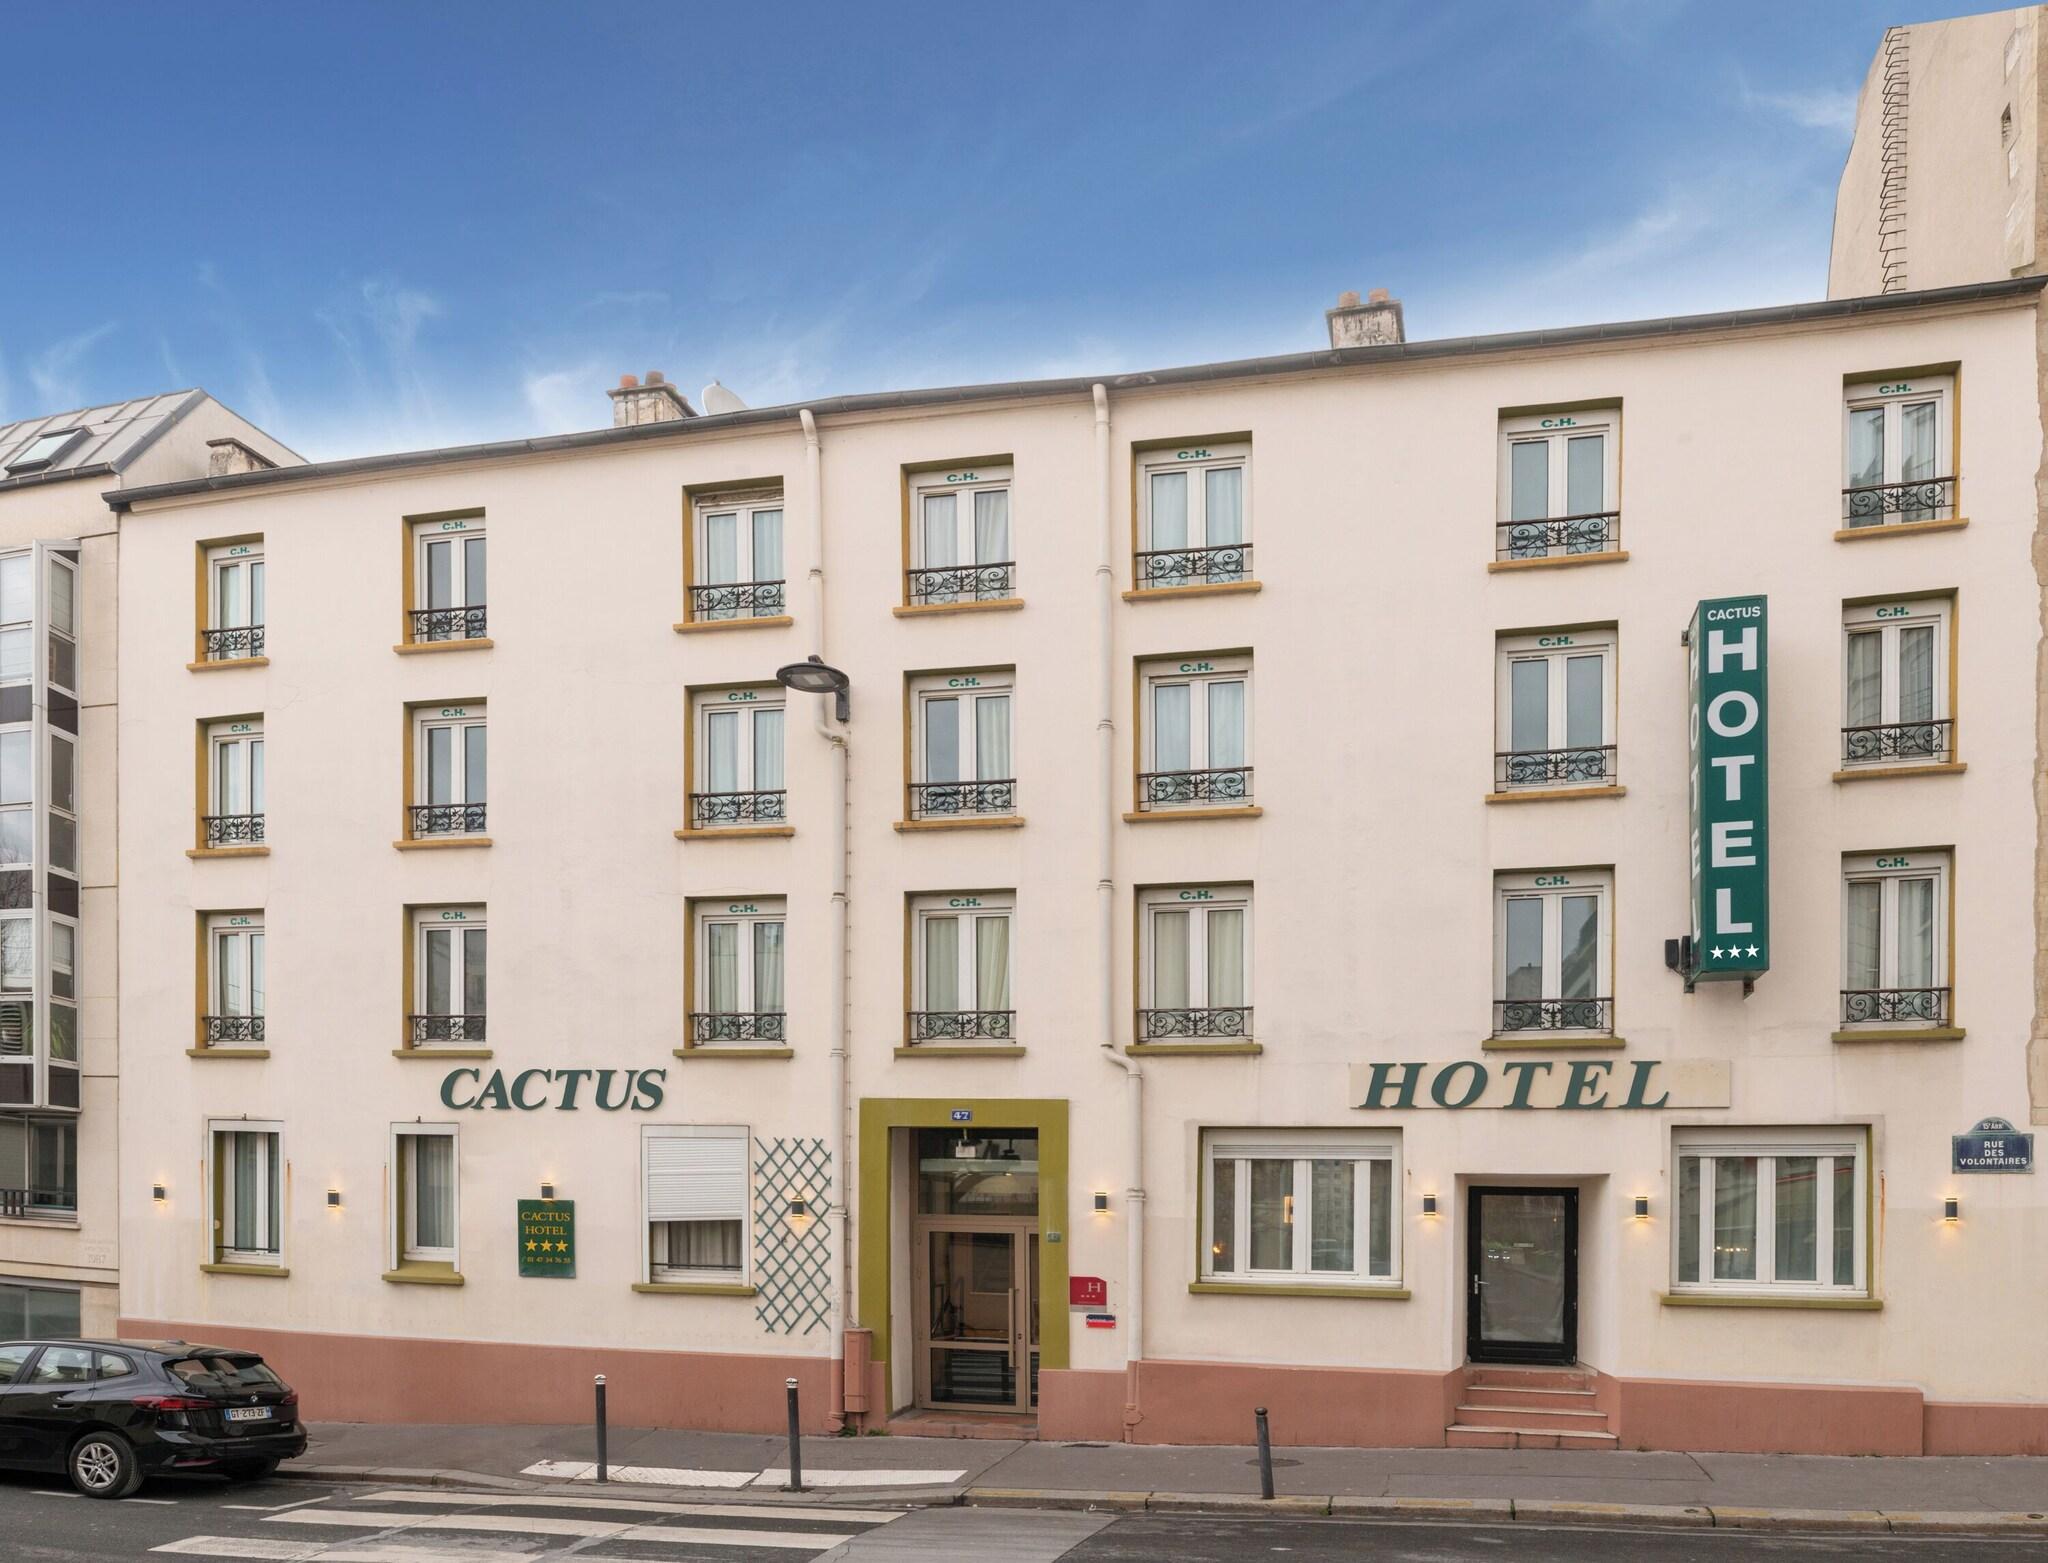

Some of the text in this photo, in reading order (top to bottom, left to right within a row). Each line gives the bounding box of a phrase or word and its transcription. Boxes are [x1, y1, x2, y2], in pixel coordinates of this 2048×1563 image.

[1879, 384, 1911, 395] C.H.
[1540, 418, 1576, 428] C.H.
[1176, 449, 1211, 461] C.H.
[945, 473, 977, 483] C.H.
[441, 522, 465, 531] C.H.
[230, 547, 250, 555] C.H.
[1707, 606, 1761, 621] CACTUS
[1876, 608, 1910, 618] C.H.
[1537, 636, 1575, 647] C.H.
[1179, 663, 1213, 672] C.H.
[947, 677, 980, 688] C.H.
[726, 693, 756, 701] C.H.
[441, 709, 464, 717] C.H.
[1707, 627, 1759, 934] HOTEL
[1876, 858, 1909, 868] C.H.
[1536, 876, 1568, 888] C.H.
[1179, 890, 1213, 901] C.H.
[949, 899, 981, 908] C.H.
[441, 912, 464, 920] C.H.
[440, 1068, 667, 1111] CACTUS
[1358, 1061, 1670, 1110] HOTEL
[953, 1111, 969, 1120] 47
[1984, 1149, 2004, 1157] DES
[1960, 1157, 2028, 1166] VOLONTAIRES
[521, 1211, 571, 1222] CACTUS
[525, 1225, 567, 1235] HOTEL
[1088, 1282, 1101, 1293] H
